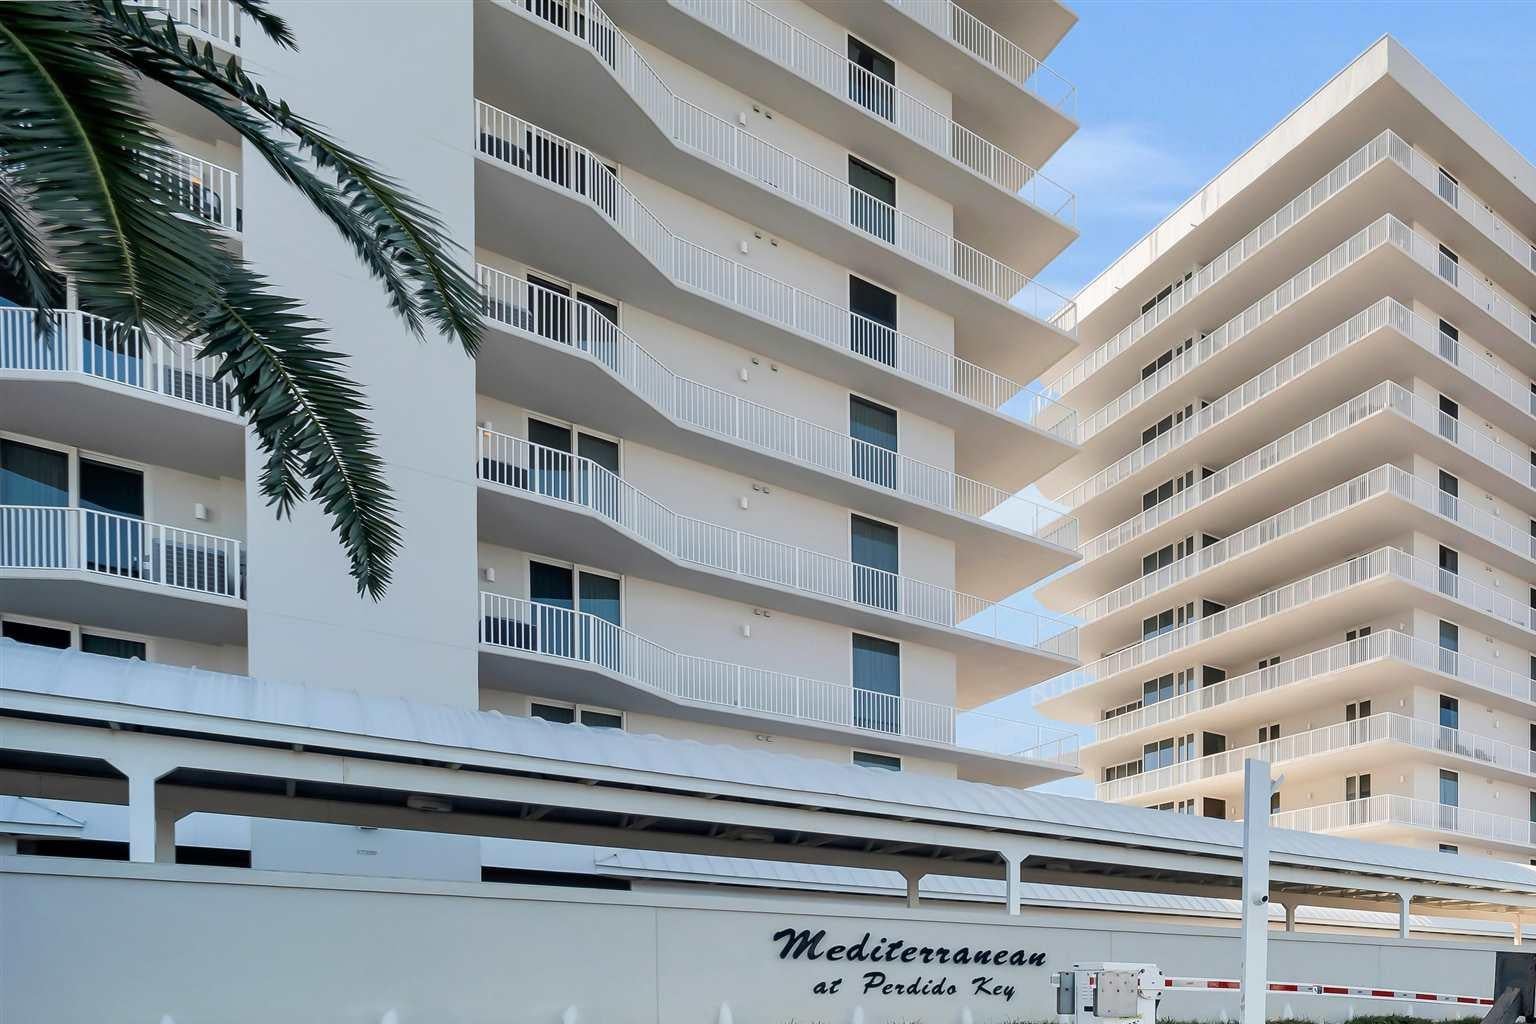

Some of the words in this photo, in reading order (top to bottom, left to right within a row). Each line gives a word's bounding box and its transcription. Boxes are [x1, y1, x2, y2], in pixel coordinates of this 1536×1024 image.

[773, 928, 1046, 967] Mediterranean
[813, 977, 842, 995] at
[863, 971, 957, 996] Perdido
[971, 976, 1015, 1001] Key
